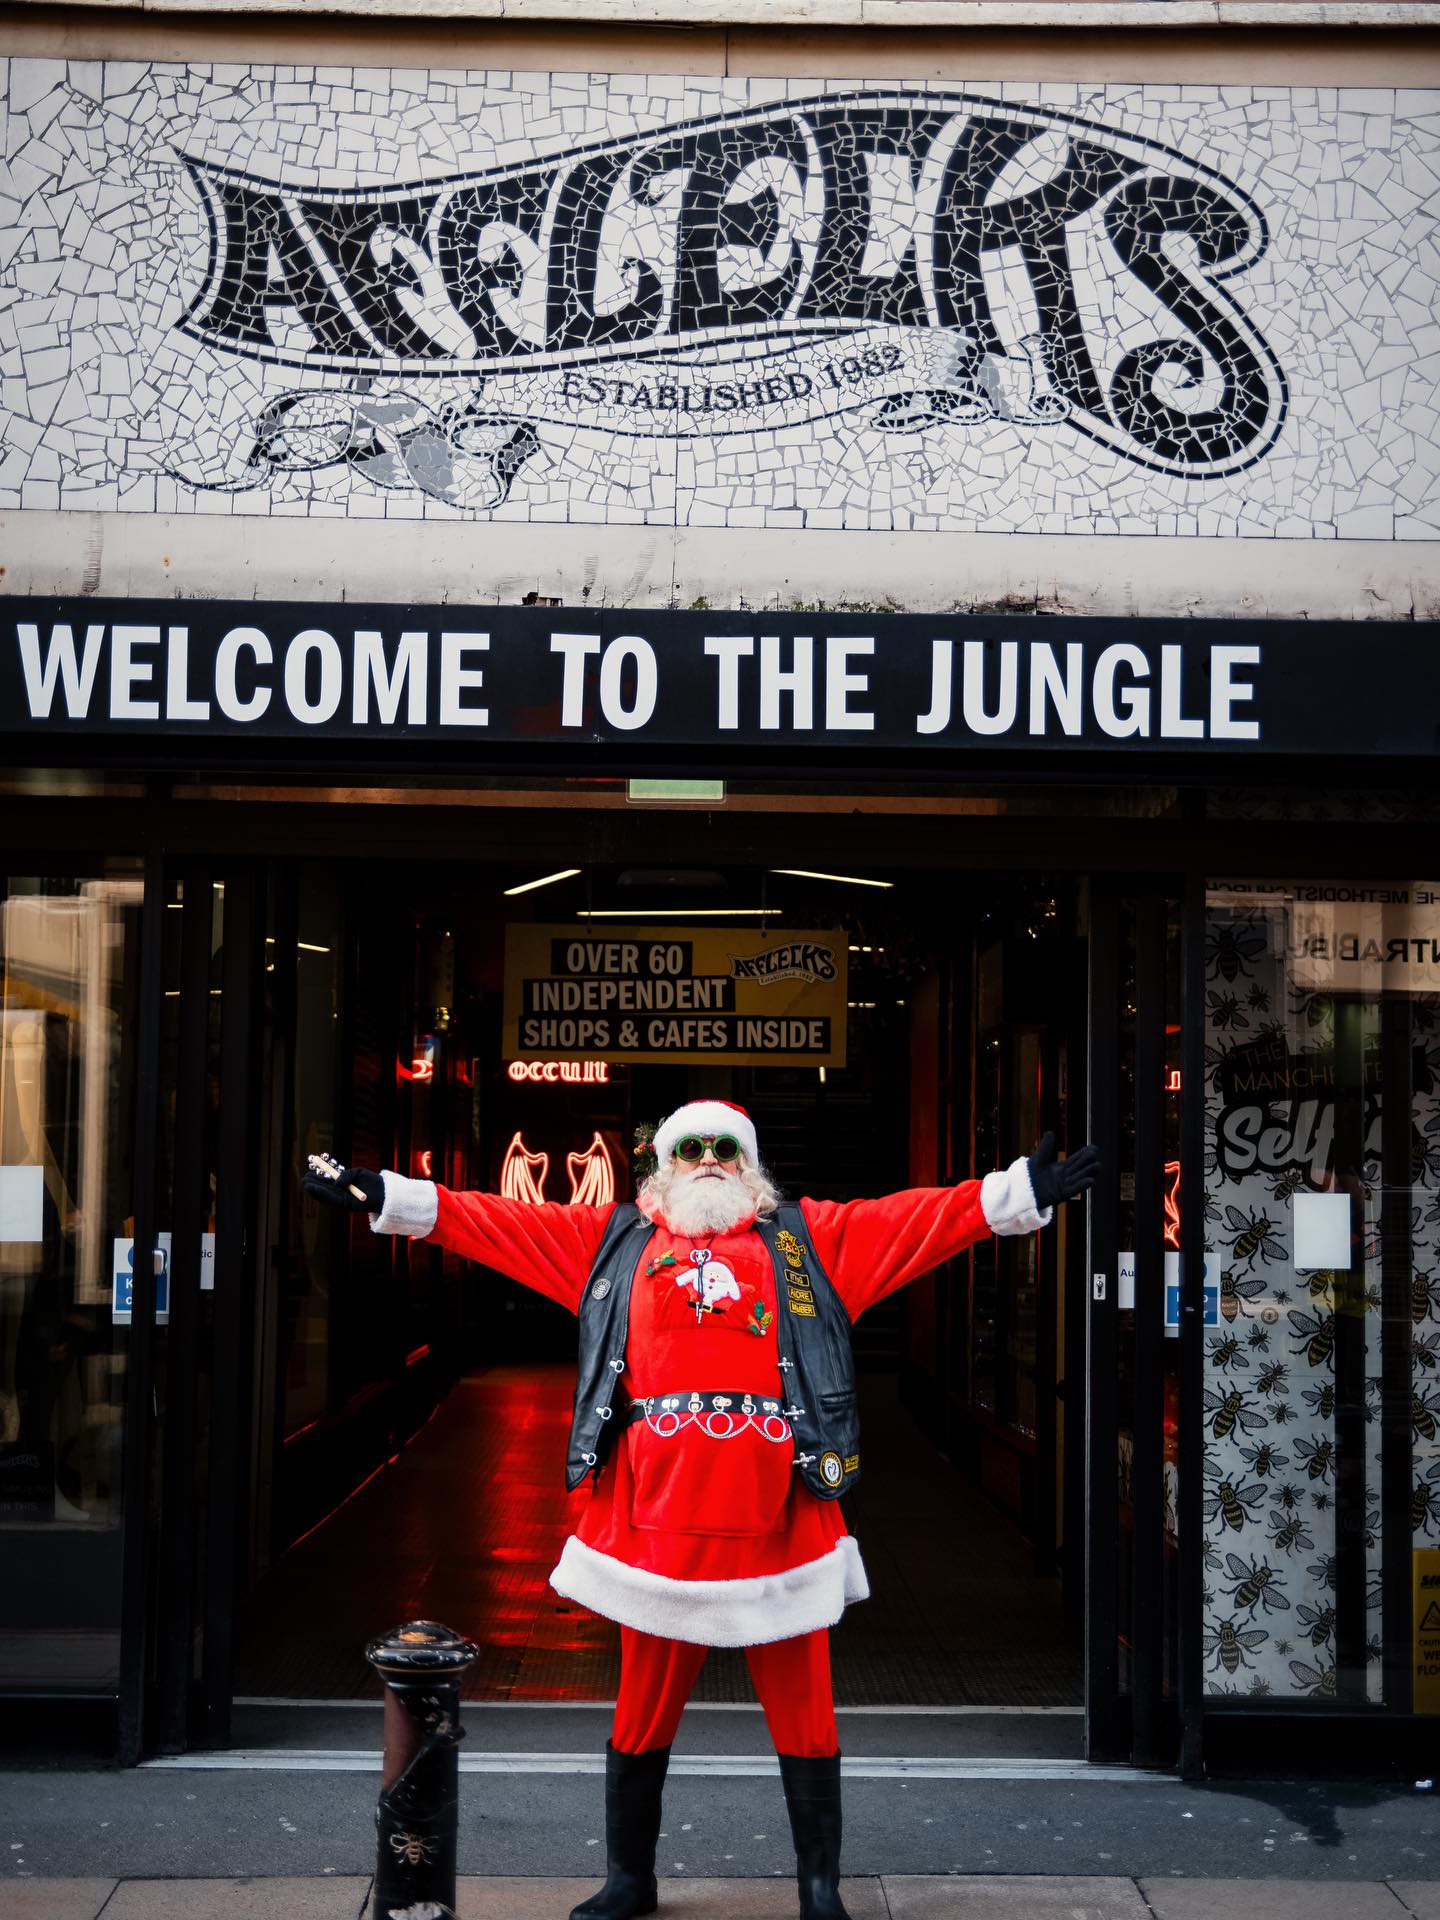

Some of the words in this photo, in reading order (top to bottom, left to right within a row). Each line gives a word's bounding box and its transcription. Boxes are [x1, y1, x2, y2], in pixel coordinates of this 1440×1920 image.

[560, 372, 813, 413] ESTABLISHED
[824, 345, 905, 388] 1982
[17, 623, 490, 727] WELCOME
[549, 633, 658, 731] TO
[704, 636, 875, 731] THE
[916, 640, 1261, 740] JUNGLE
[567, 943, 638, 974] OVER
[649, 944, 684, 975] 60
[532, 979, 727, 1012] INDEPENDENT
[523, 1019, 611, 1048] SHOPS
[618, 1019, 639, 1048] &
[648, 1019, 728, 1049] CAFES
[737, 1020, 824, 1049] INSIDE
[1240, 1042, 1285, 1069] THE
